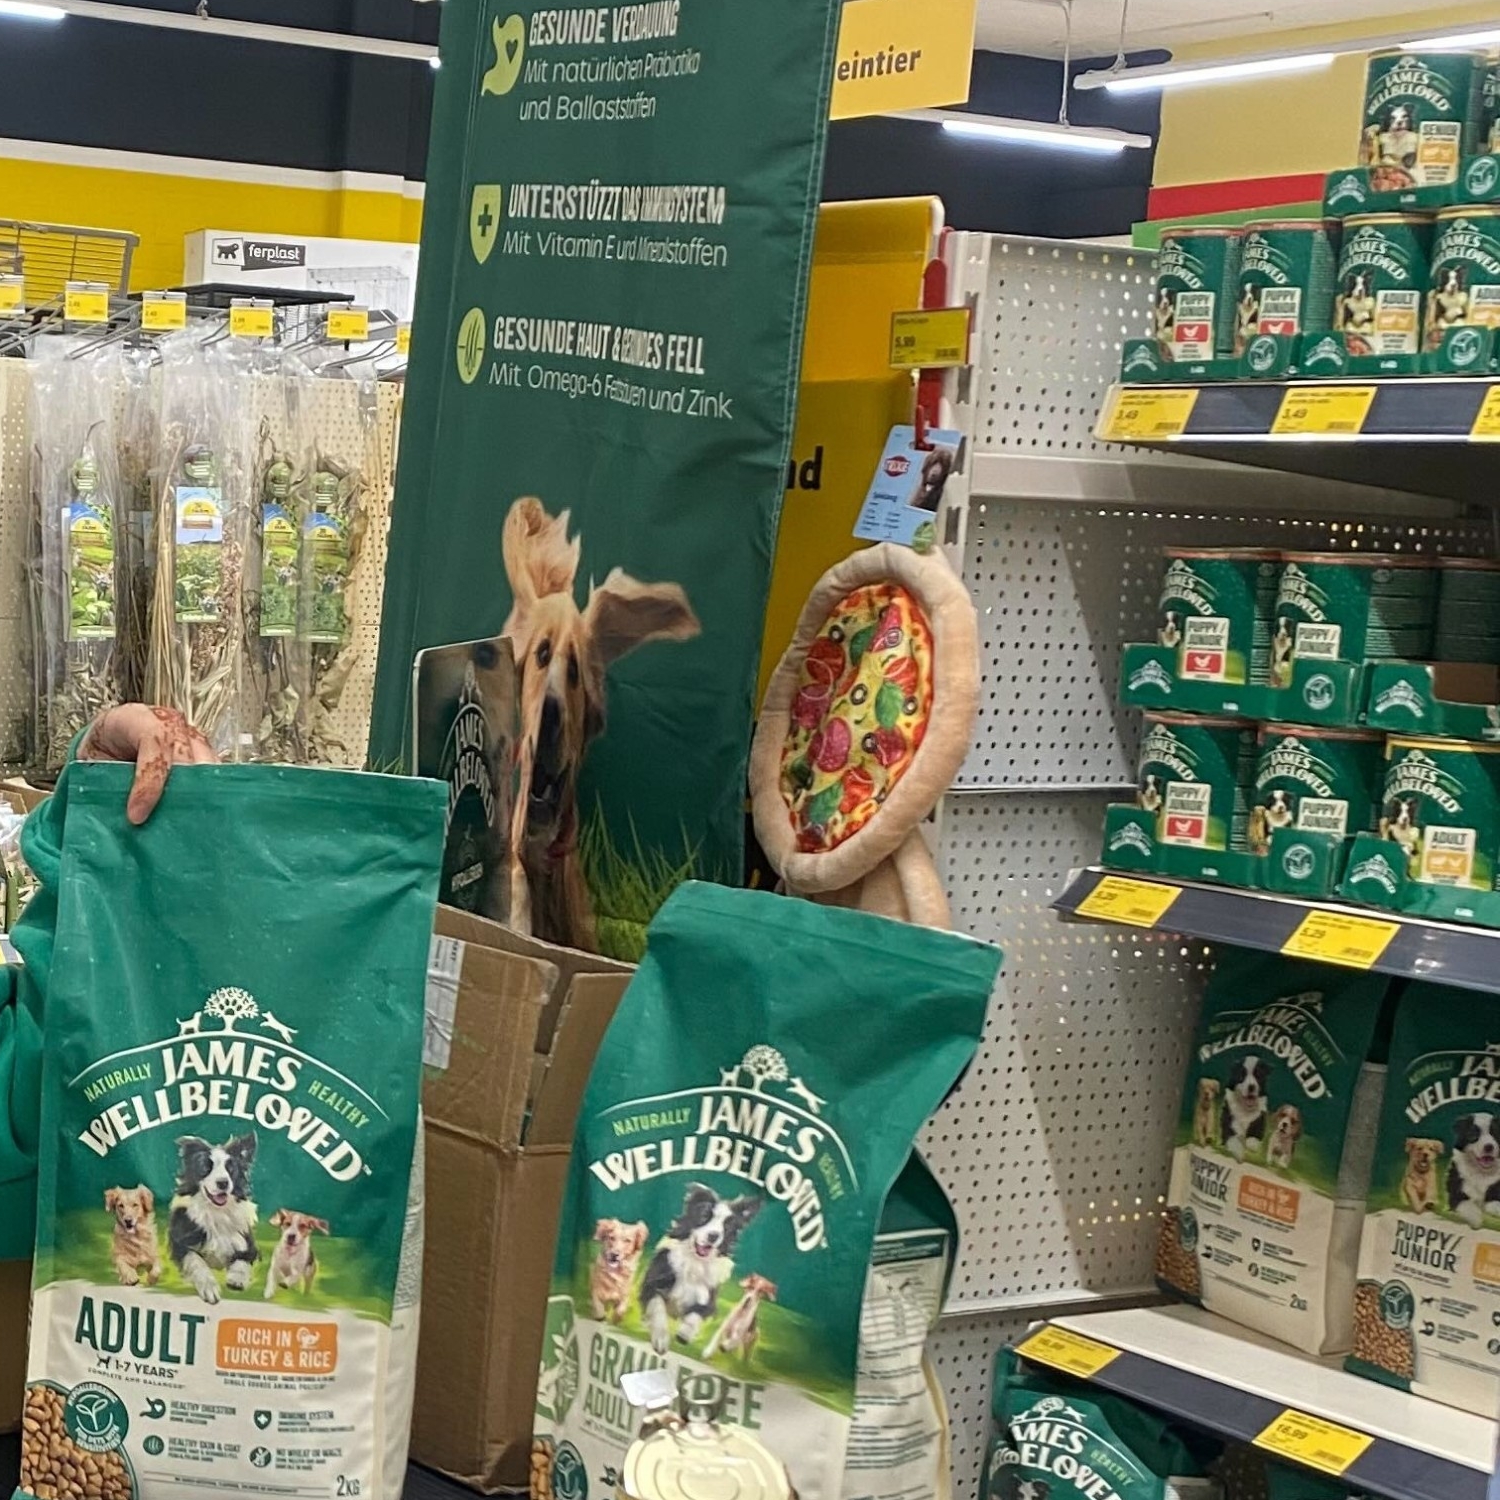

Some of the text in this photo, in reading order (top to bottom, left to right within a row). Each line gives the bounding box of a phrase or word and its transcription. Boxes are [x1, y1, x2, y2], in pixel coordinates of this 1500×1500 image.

[529, 7, 608, 47] GESUNDE
[524, 59, 547, 84] Mit
[552, 55, 644, 83] natürlichen
[837, 45, 921, 82] eintier
[519, 95, 550, 120] und
[508, 178, 622, 221] UNTERSTÜTZT
[248, 243, 300, 261] ferplast
[502, 230, 531, 256] Mit
[537, 231, 603, 259] Vitamin
[605, 235, 616, 259] E
[493, 316, 576, 355] GESUNDE
[577, 322, 611, 360] HAUT
[611, 326, 622, 362] &
[665, 334, 705, 375] FELL
[488, 361, 733, 420] Mit Omega-6 und Zink
[161, 1039, 304, 1093] JAMES
[1459, 1054, 1500, 1078] JA
[84, 1062, 371, 1129] NATURALLY HEALTHY
[77, 1079, 364, 1183] WELLBELOVED
[612, 1107, 691, 1137] NATURALLY
[694, 1095, 825, 1164] JAMES
[588, 1135, 826, 1252] WELLBELOVED
[1395, 1219, 1466, 1254] PUPPY/
[1390, 1239, 1459, 1275] JUNIOR
[75, 1295, 206, 1366] ADULT
[237, 1327, 292, 1348] RICH IN
[222, 1346, 332, 1368] TURKEY & RICE
[589, 1333, 667, 1388] GRA
[335, 1474, 361, 1498] 2KG
